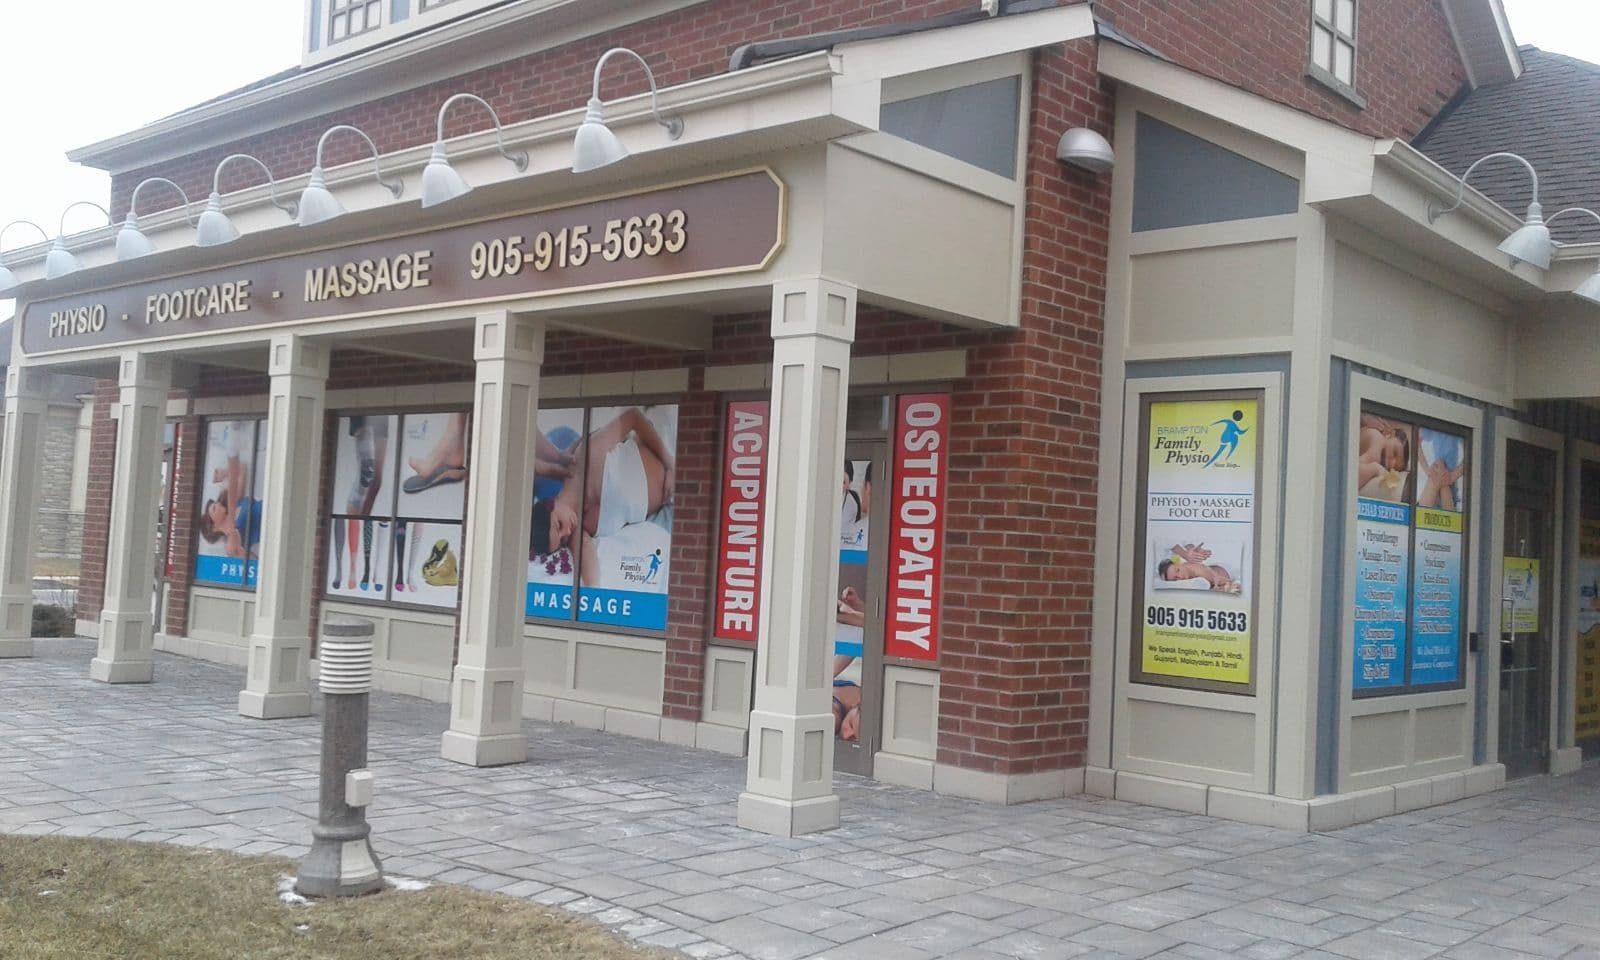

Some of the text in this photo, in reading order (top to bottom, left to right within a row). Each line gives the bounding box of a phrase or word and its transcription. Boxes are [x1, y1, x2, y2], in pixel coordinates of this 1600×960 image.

[48, 209, 687, 338] PHYSIO FOOTCARE MASSAGE 905-915-5633
[1157, 426, 1208, 435] BRAMPTON
[1154, 436, 1202, 452] Family
[1165, 450, 1210, 466] Physio
[1151, 497, 1251, 508] PHYSIO MASSAGE
[723, 410, 763, 632] ACUPUNTURE
[1169, 508, 1231, 518] FOOT CARE
[895, 402, 942, 651] OSTEOPATHY
[620, 562, 641, 571] Family
[533, 591, 632, 615] MASSAGE
[1147, 606, 1247, 632] 905 915 5633
